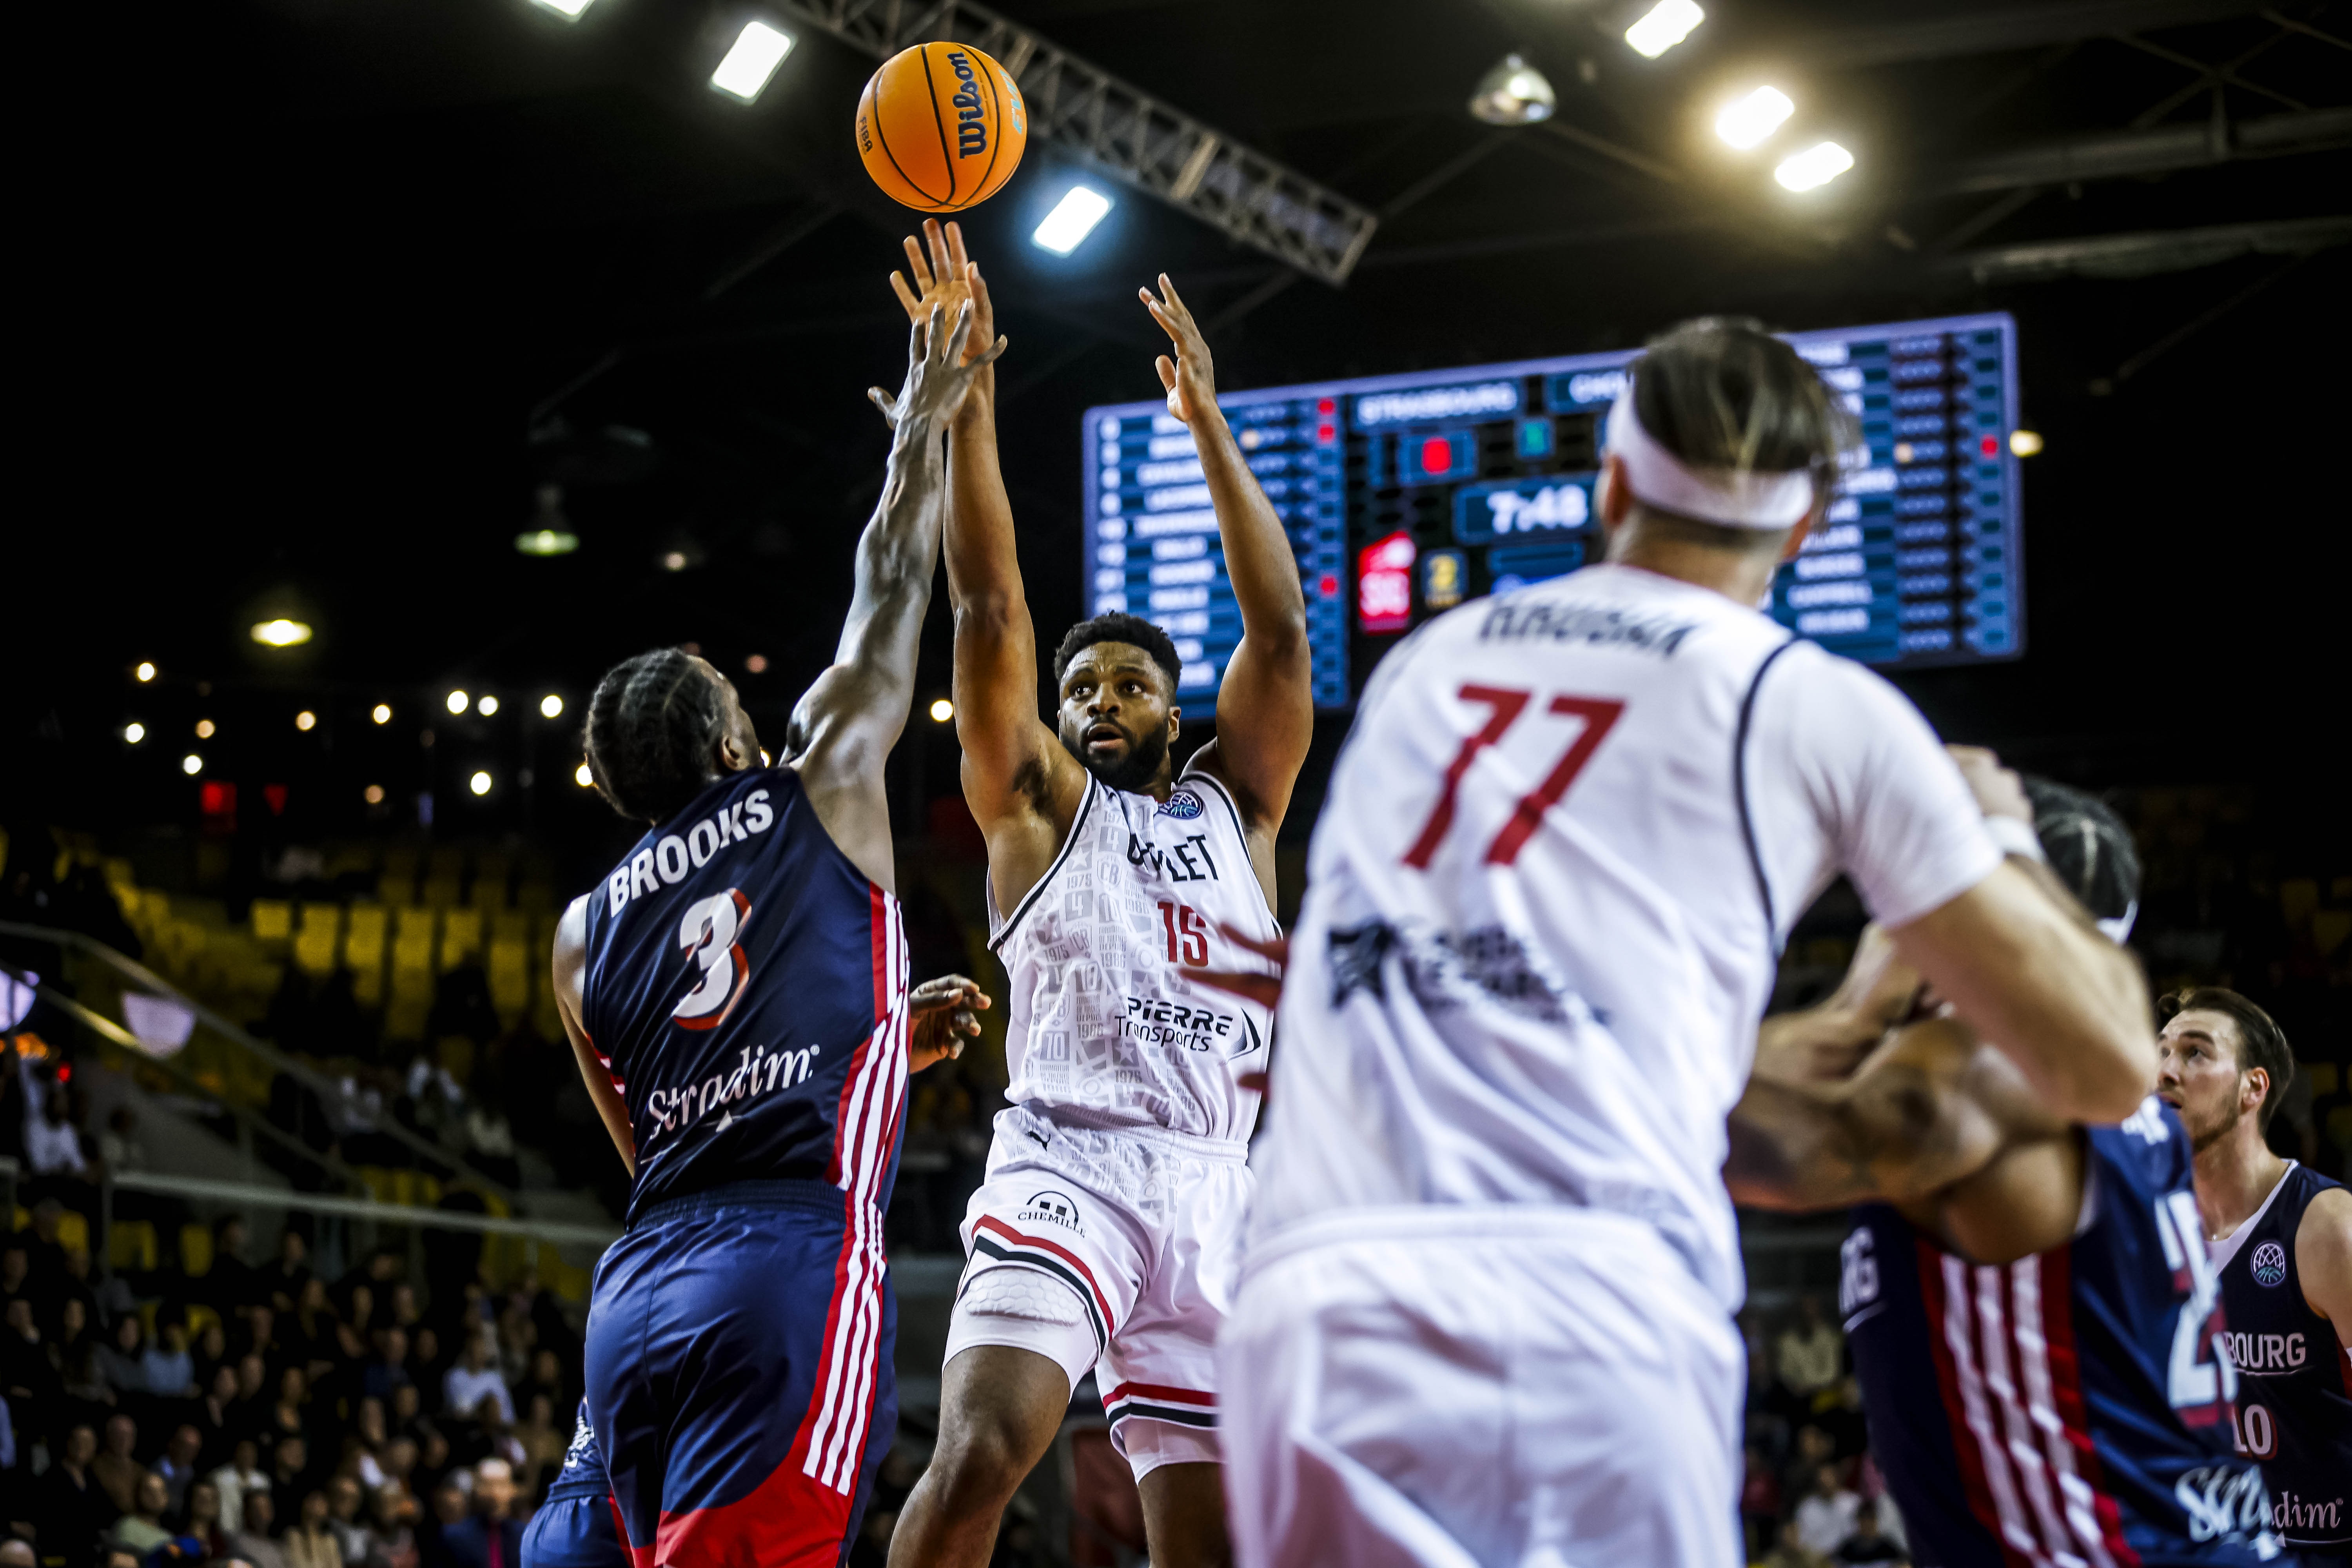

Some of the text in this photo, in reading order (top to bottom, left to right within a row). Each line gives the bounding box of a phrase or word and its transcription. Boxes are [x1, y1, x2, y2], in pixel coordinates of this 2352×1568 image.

[947, 52, 987, 159] Wilson
[1401, 682, 1628, 869] 77
[609, 788, 773, 918] BROOKS
[671, 887, 752, 1030] 3
[1157, 902, 1209, 967] 15
[1114, 1015, 1212, 1052] Transports
